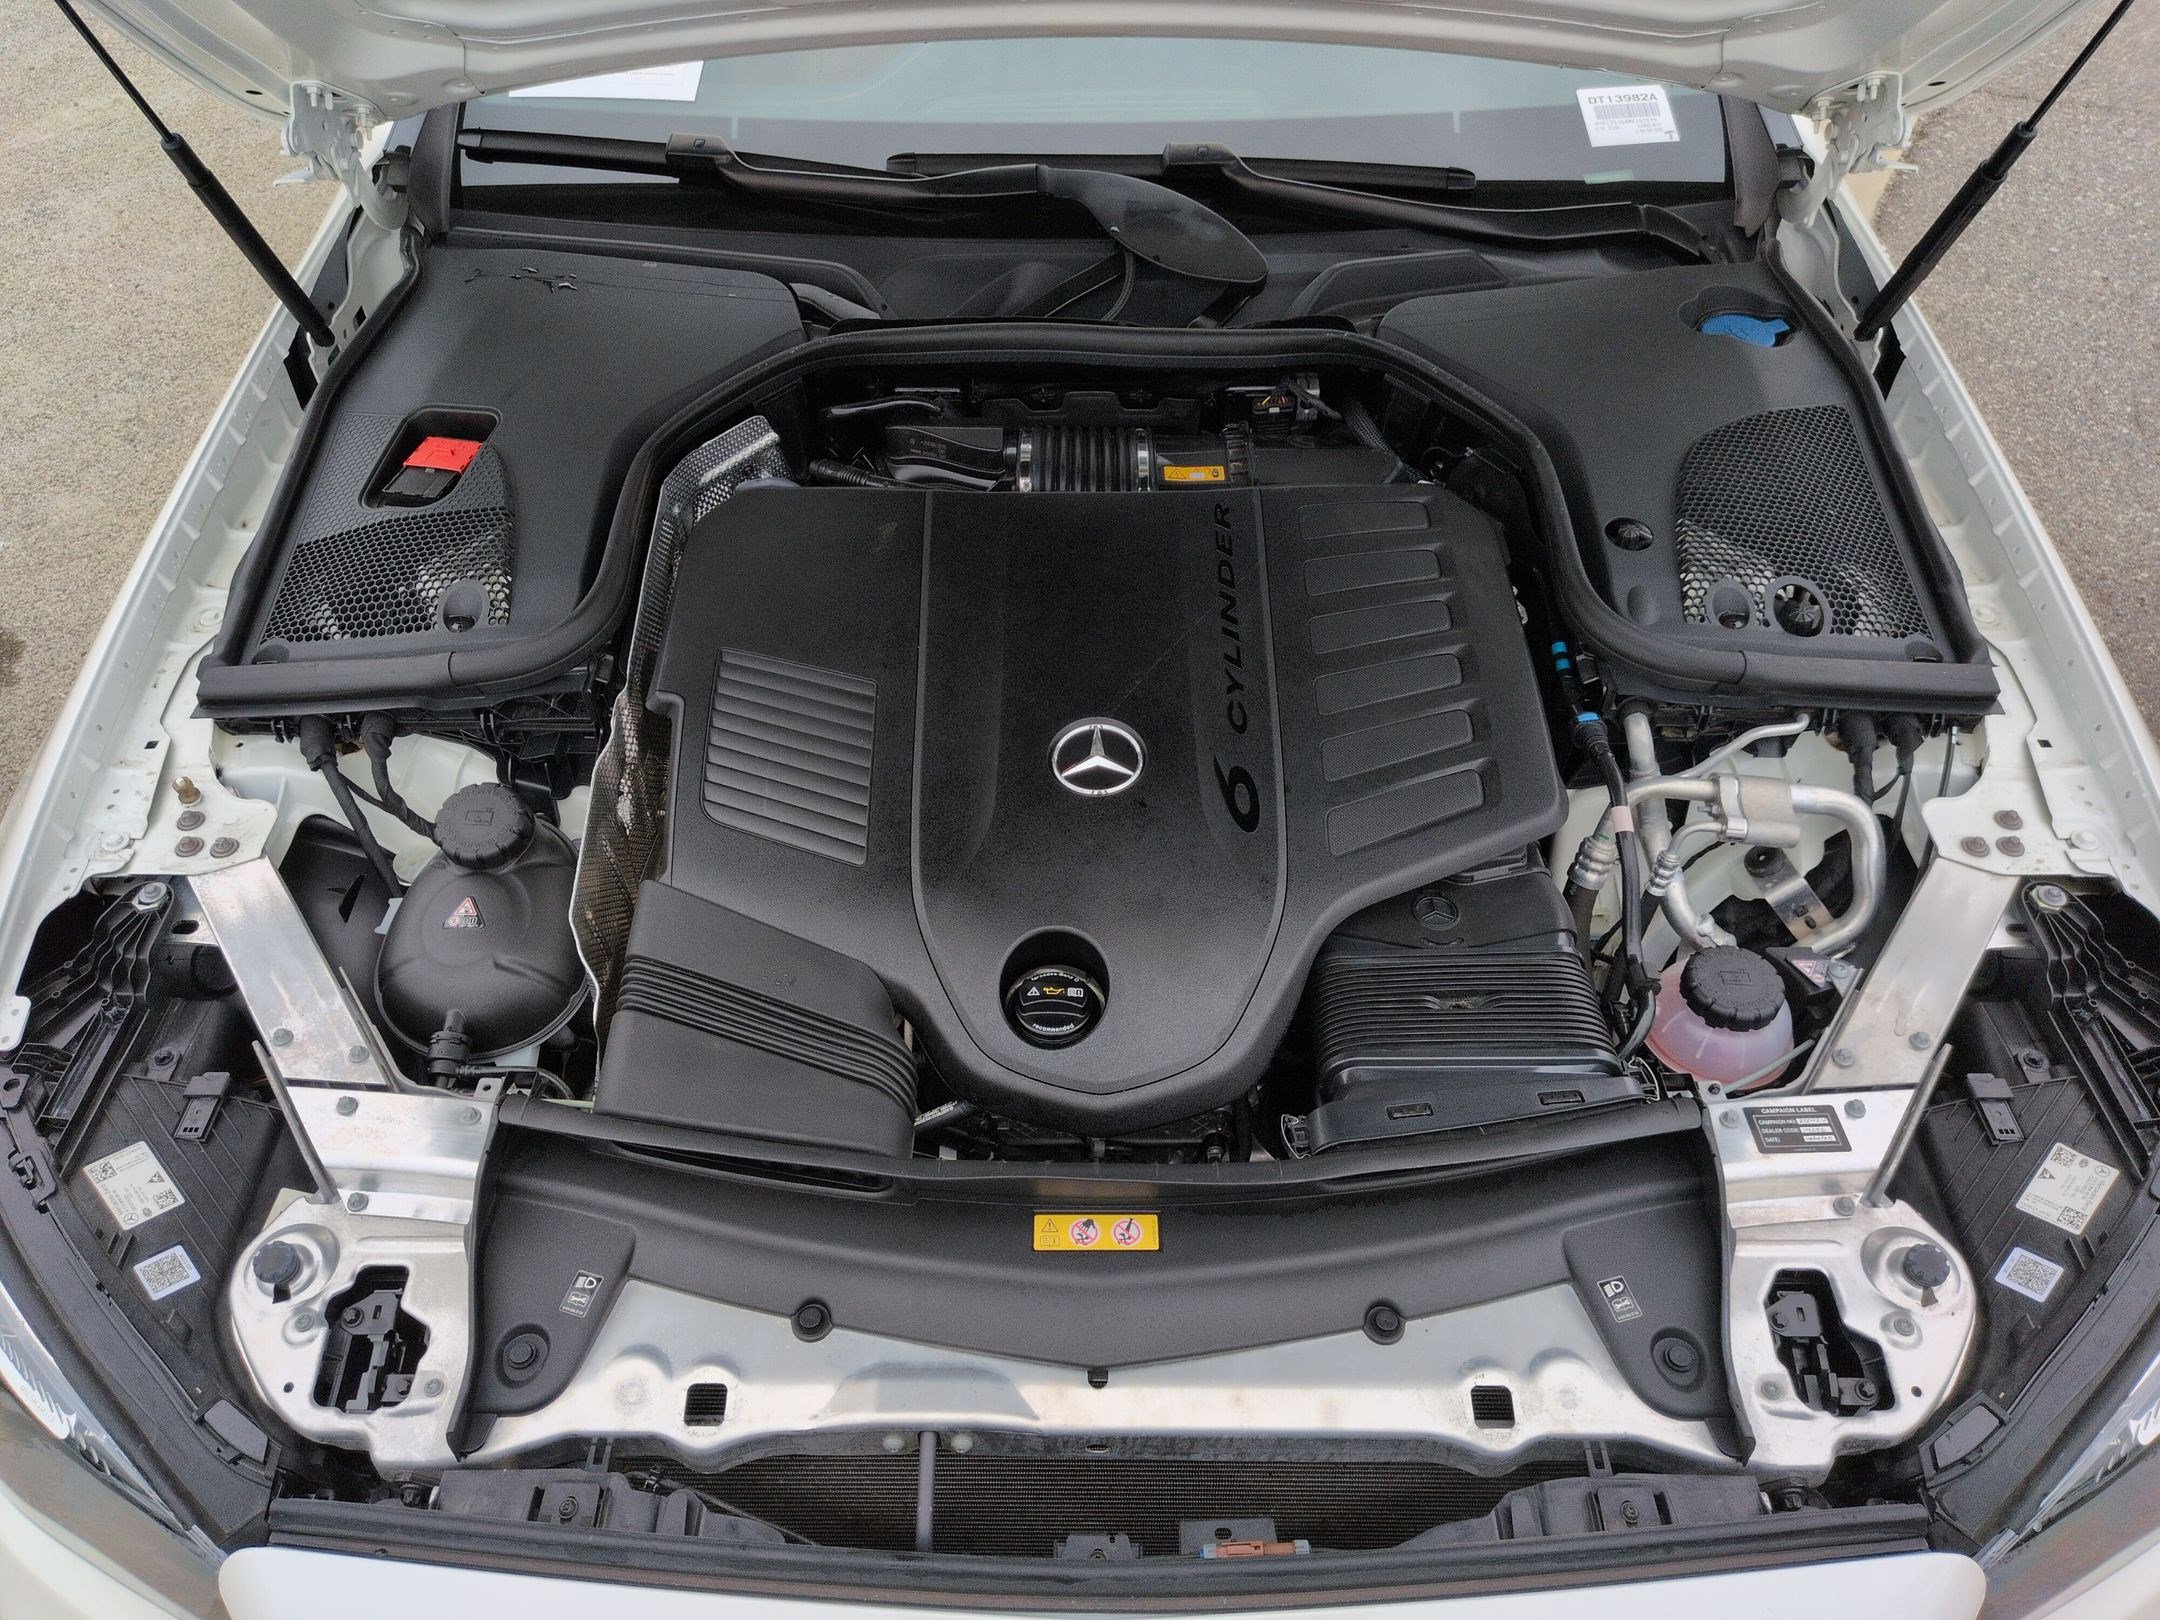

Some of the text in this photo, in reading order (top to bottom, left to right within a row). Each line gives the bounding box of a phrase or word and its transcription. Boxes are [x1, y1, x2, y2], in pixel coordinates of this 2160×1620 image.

[1588, 93, 1658, 105] DT13982A
[1213, 503, 1260, 833] 6 CYLINDER
